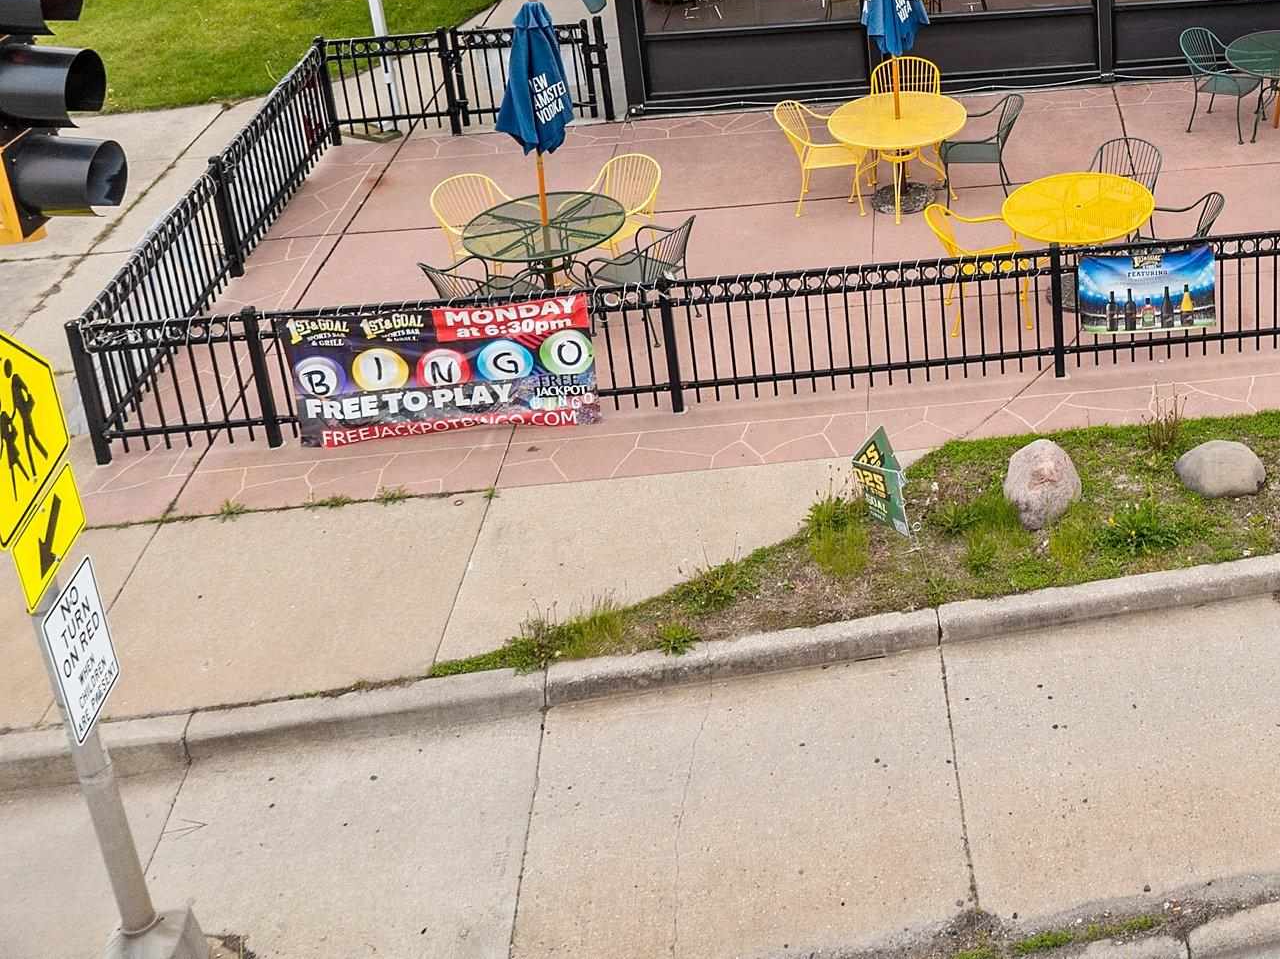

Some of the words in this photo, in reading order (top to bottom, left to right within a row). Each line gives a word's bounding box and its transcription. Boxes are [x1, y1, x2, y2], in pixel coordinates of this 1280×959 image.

[445, 296, 576, 326] MONDAY
[456, 326, 480, 338] at
[484, 316, 572, 337] 6:30pm
[536, 385, 587, 397] JACKPOT
[538, 374, 580, 387] FREE
[306, 396, 379, 421] FREE
[383, 392, 427, 418] TO
[432, 383, 512, 409] PLAY
[60, 585, 79, 622] NO
[60, 595, 91, 649] TURN
[63, 646, 80, 679] ON
[79, 610, 100, 653] RED
[77, 653, 96, 684] WHEN
[78, 655, 107, 710] CHILDREN
[77, 711, 92, 734] ARE
[90, 660, 116, 708] PRESENT
